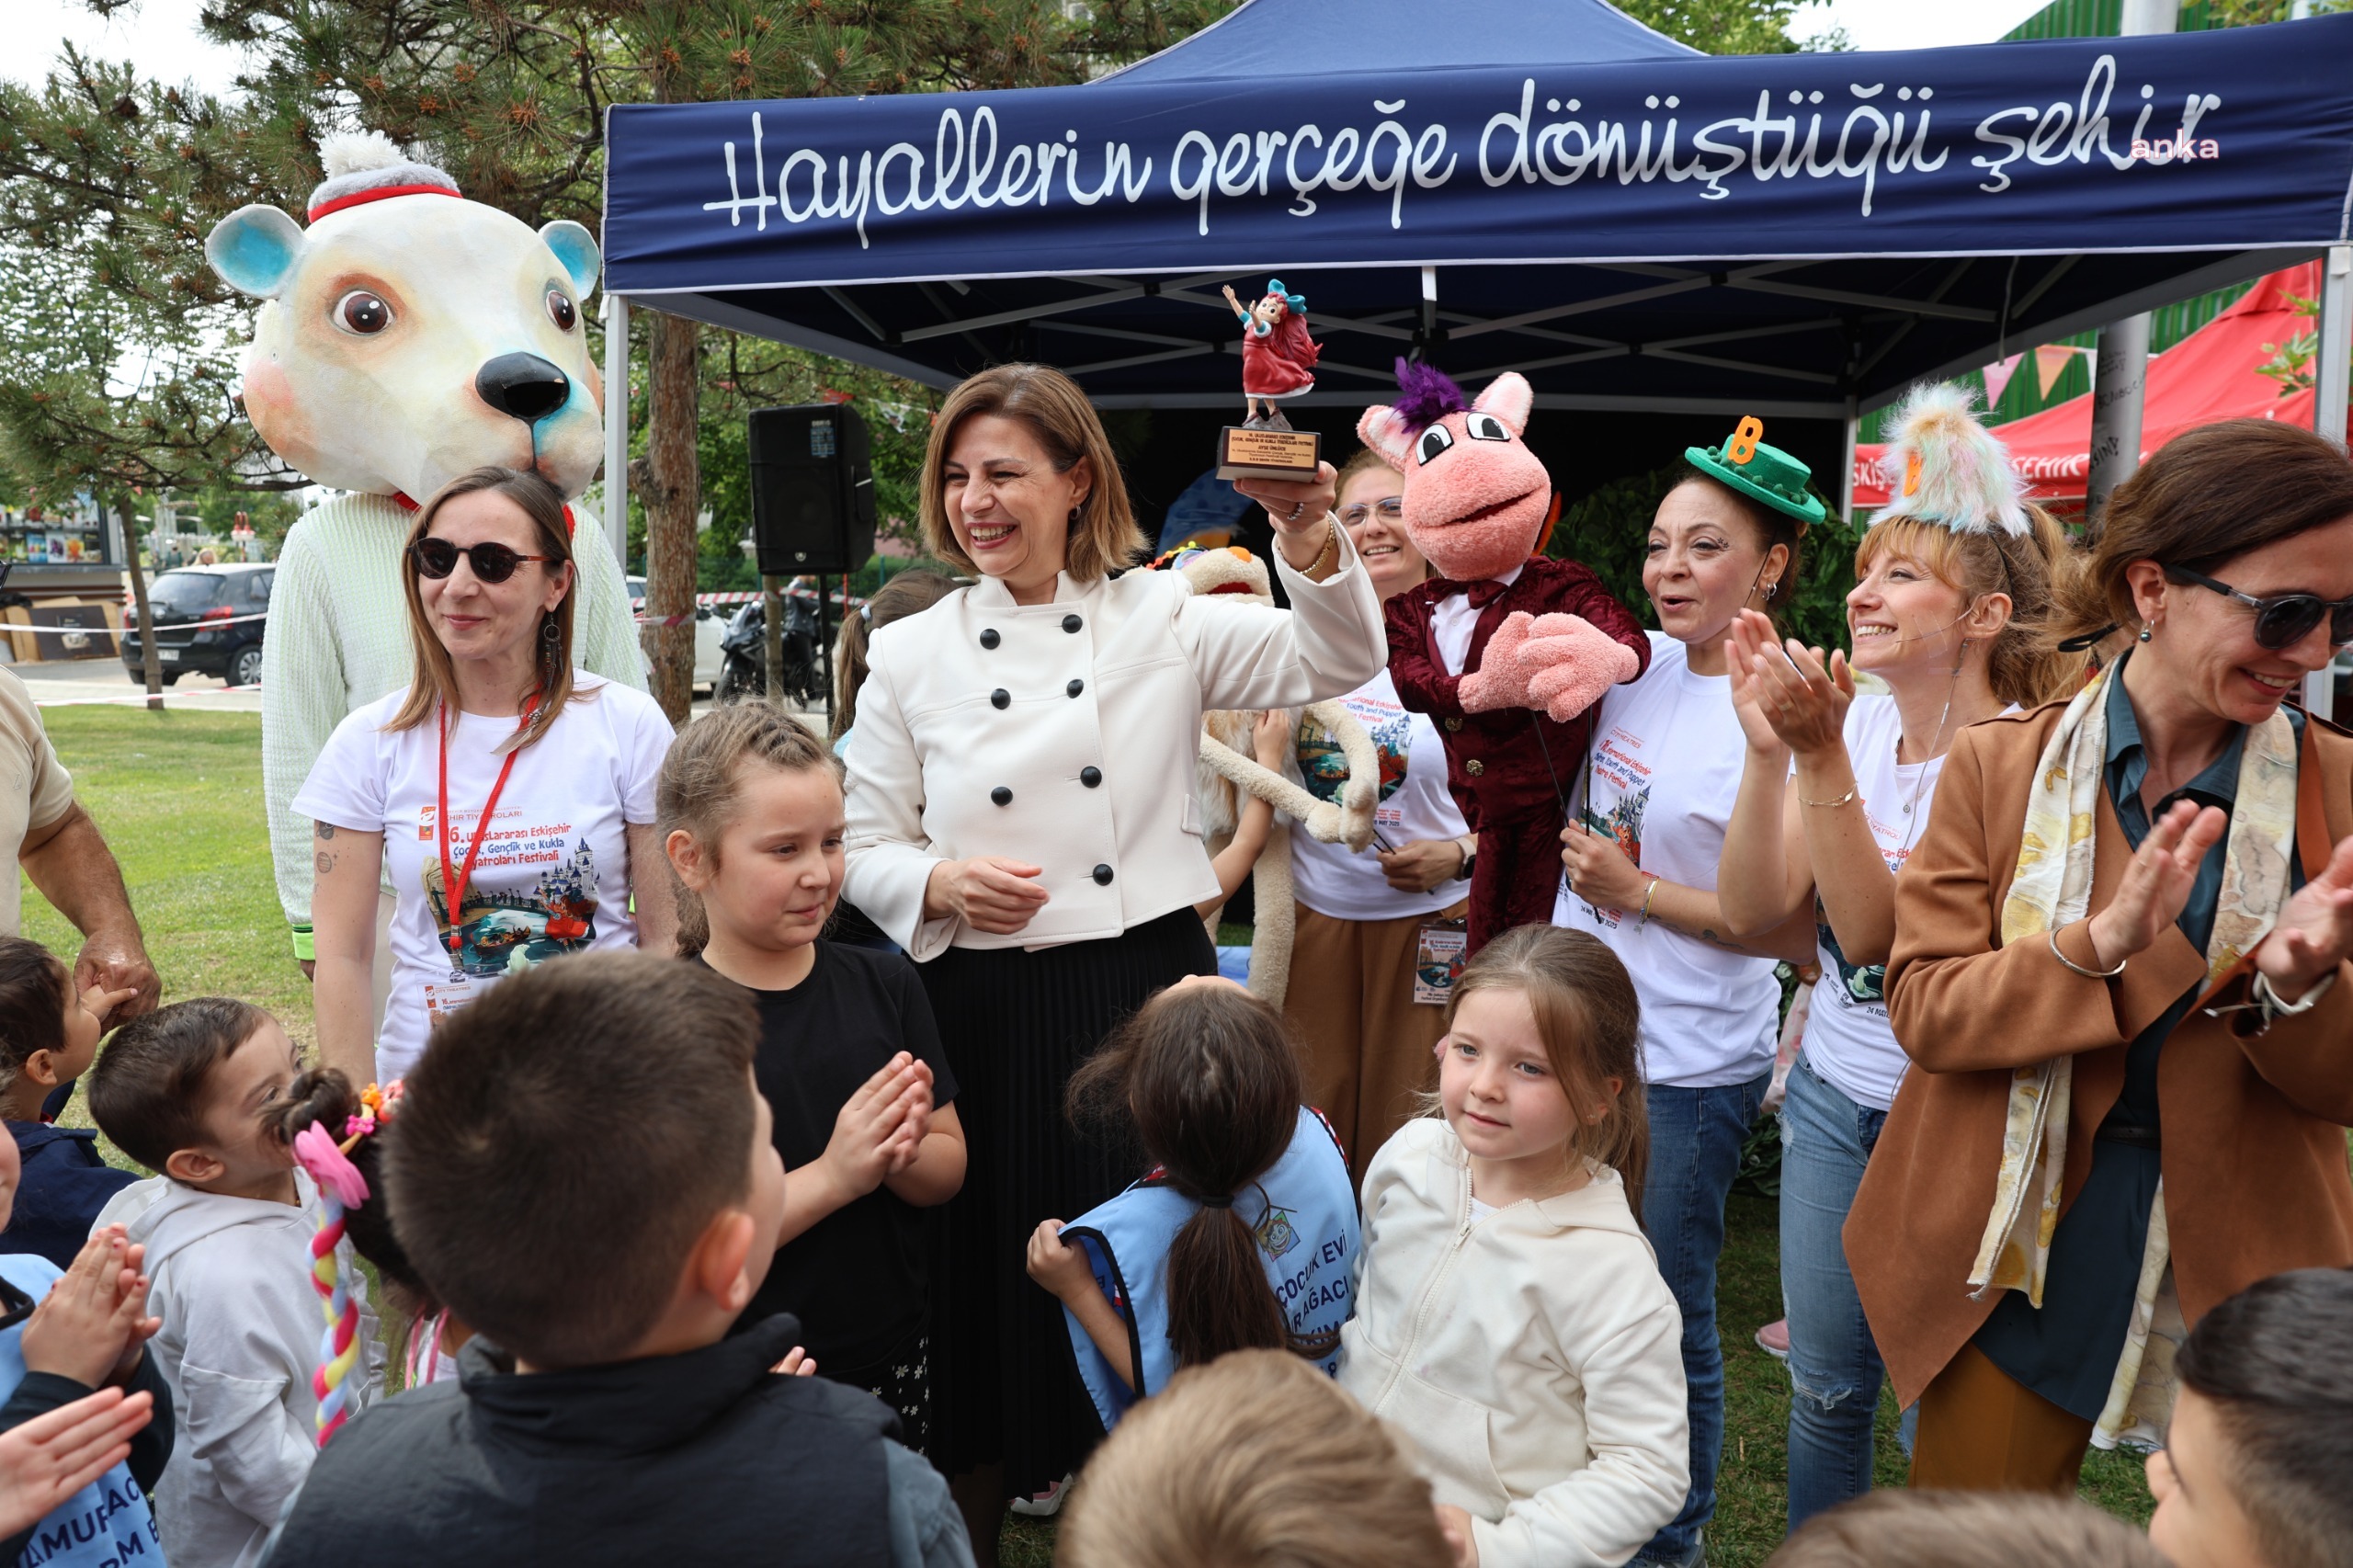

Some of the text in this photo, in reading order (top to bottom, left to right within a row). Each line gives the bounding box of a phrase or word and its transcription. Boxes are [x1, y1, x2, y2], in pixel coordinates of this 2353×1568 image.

[703, 54, 2222, 249] Hayallerin gerçeğe dönüştüğü şehir
[449, 826, 465, 843] 6.
[530, 823, 572, 837] Eskişehir
[524, 842, 536, 850] ve
[539, 837, 565, 849] Kukla
[518, 849, 559, 863] Festivali
[1866, 1006, 1874, 1015] 24
[1275, 1251, 1320, 1309] ÇOCUK
[1322, 1228, 1347, 1265] EVİ
